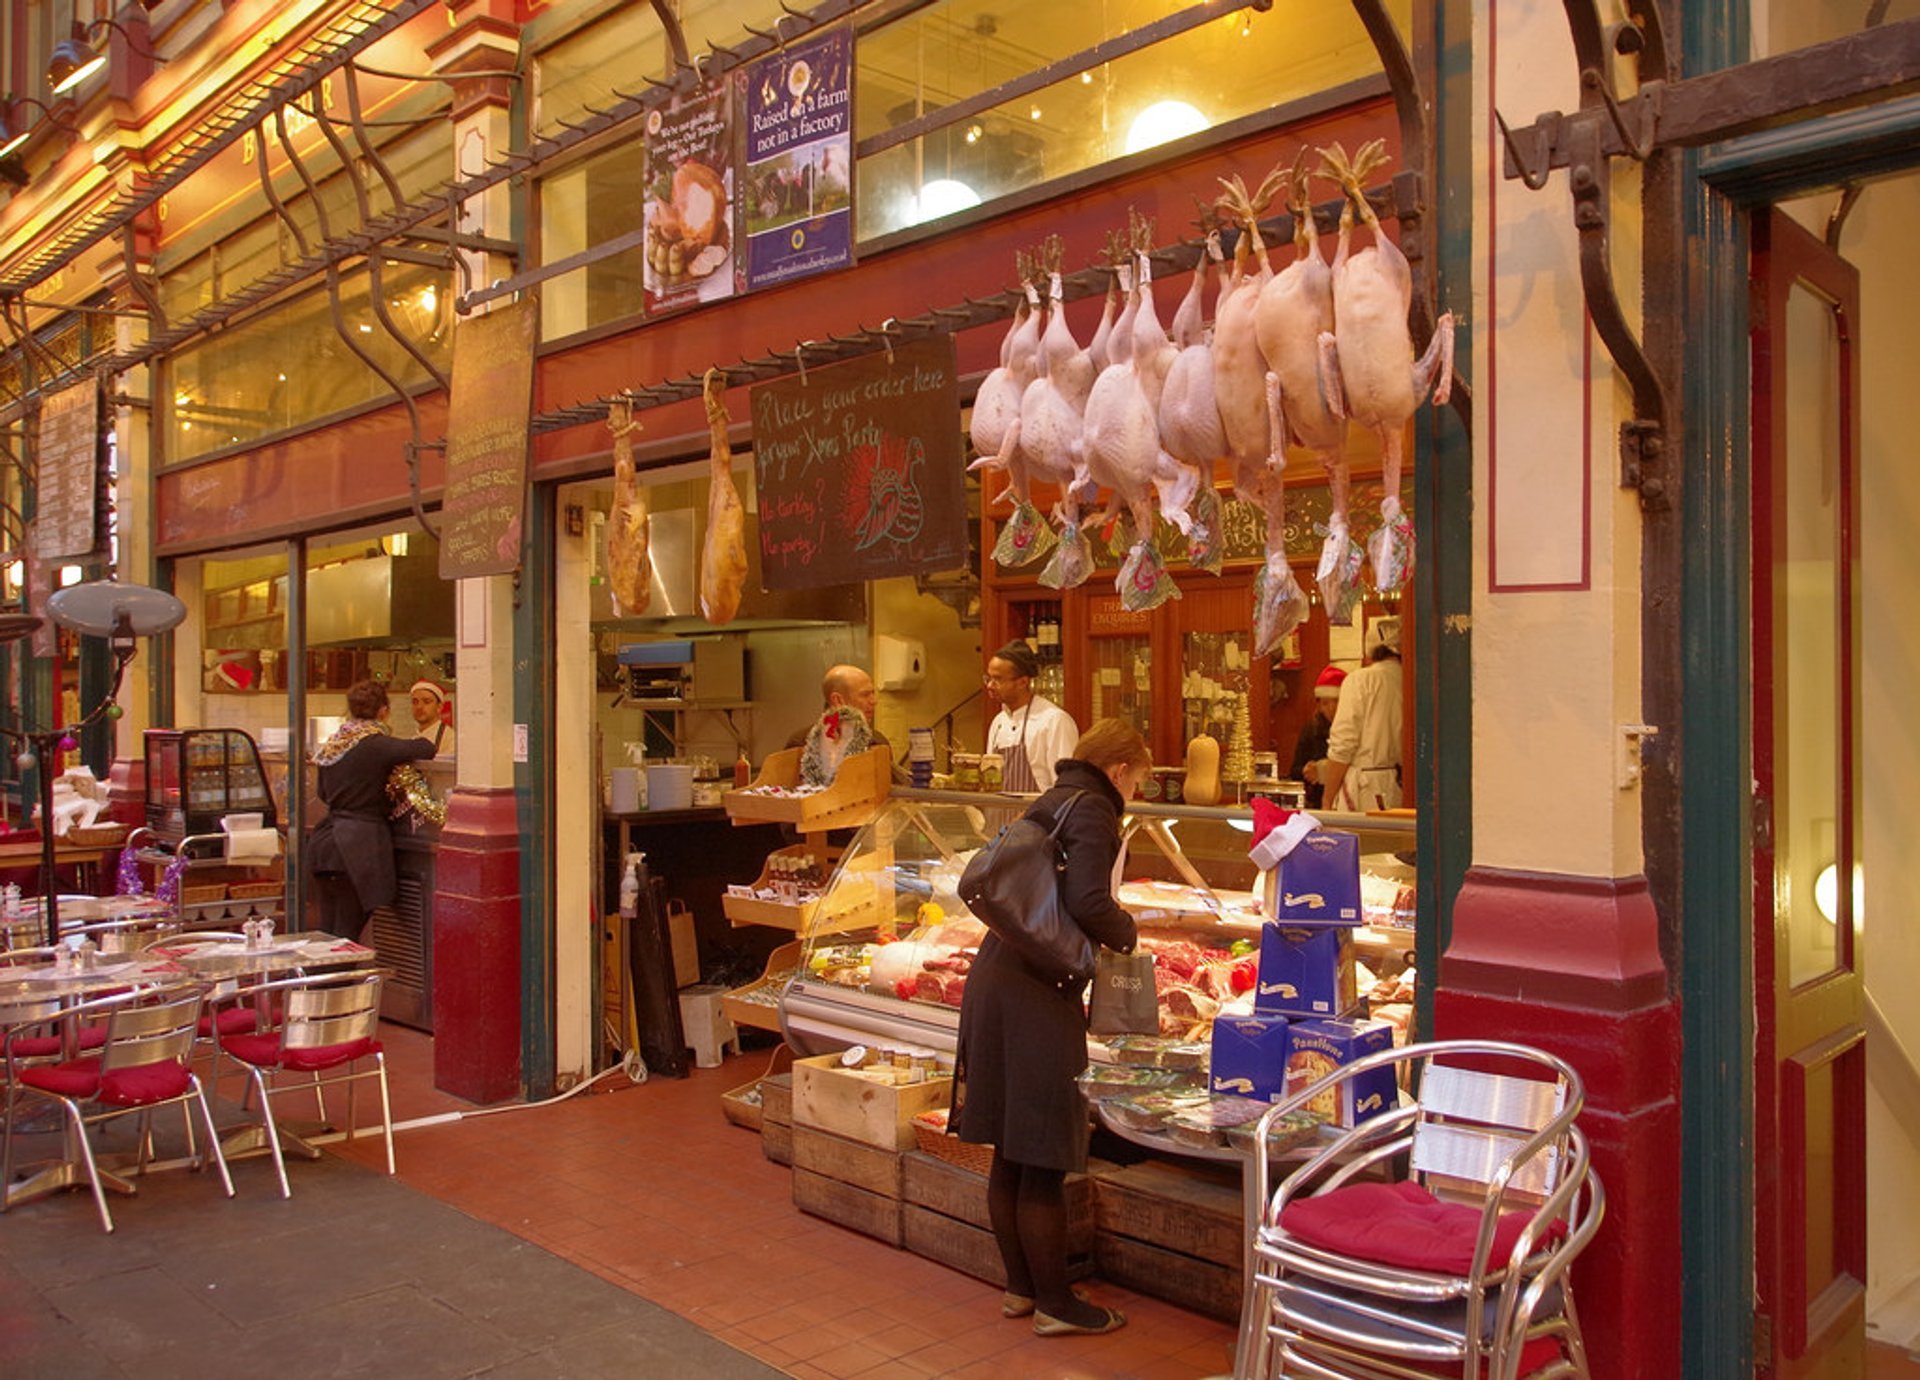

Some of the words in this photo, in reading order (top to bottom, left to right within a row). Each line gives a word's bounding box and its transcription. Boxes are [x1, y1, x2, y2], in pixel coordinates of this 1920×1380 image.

[753, 101, 789, 133] Raised
[817, 87, 848, 110] farm
[757, 134, 777, 153] not
[777, 127, 789, 145] in
[790, 127, 799, 140] a
[799, 112, 844, 137] factory
[759, 391, 815, 433] Place
[822, 388, 858, 424] your
[864, 376, 912, 399] order
[914, 365, 946, 393] here
[801, 424, 840, 479] Xmas
